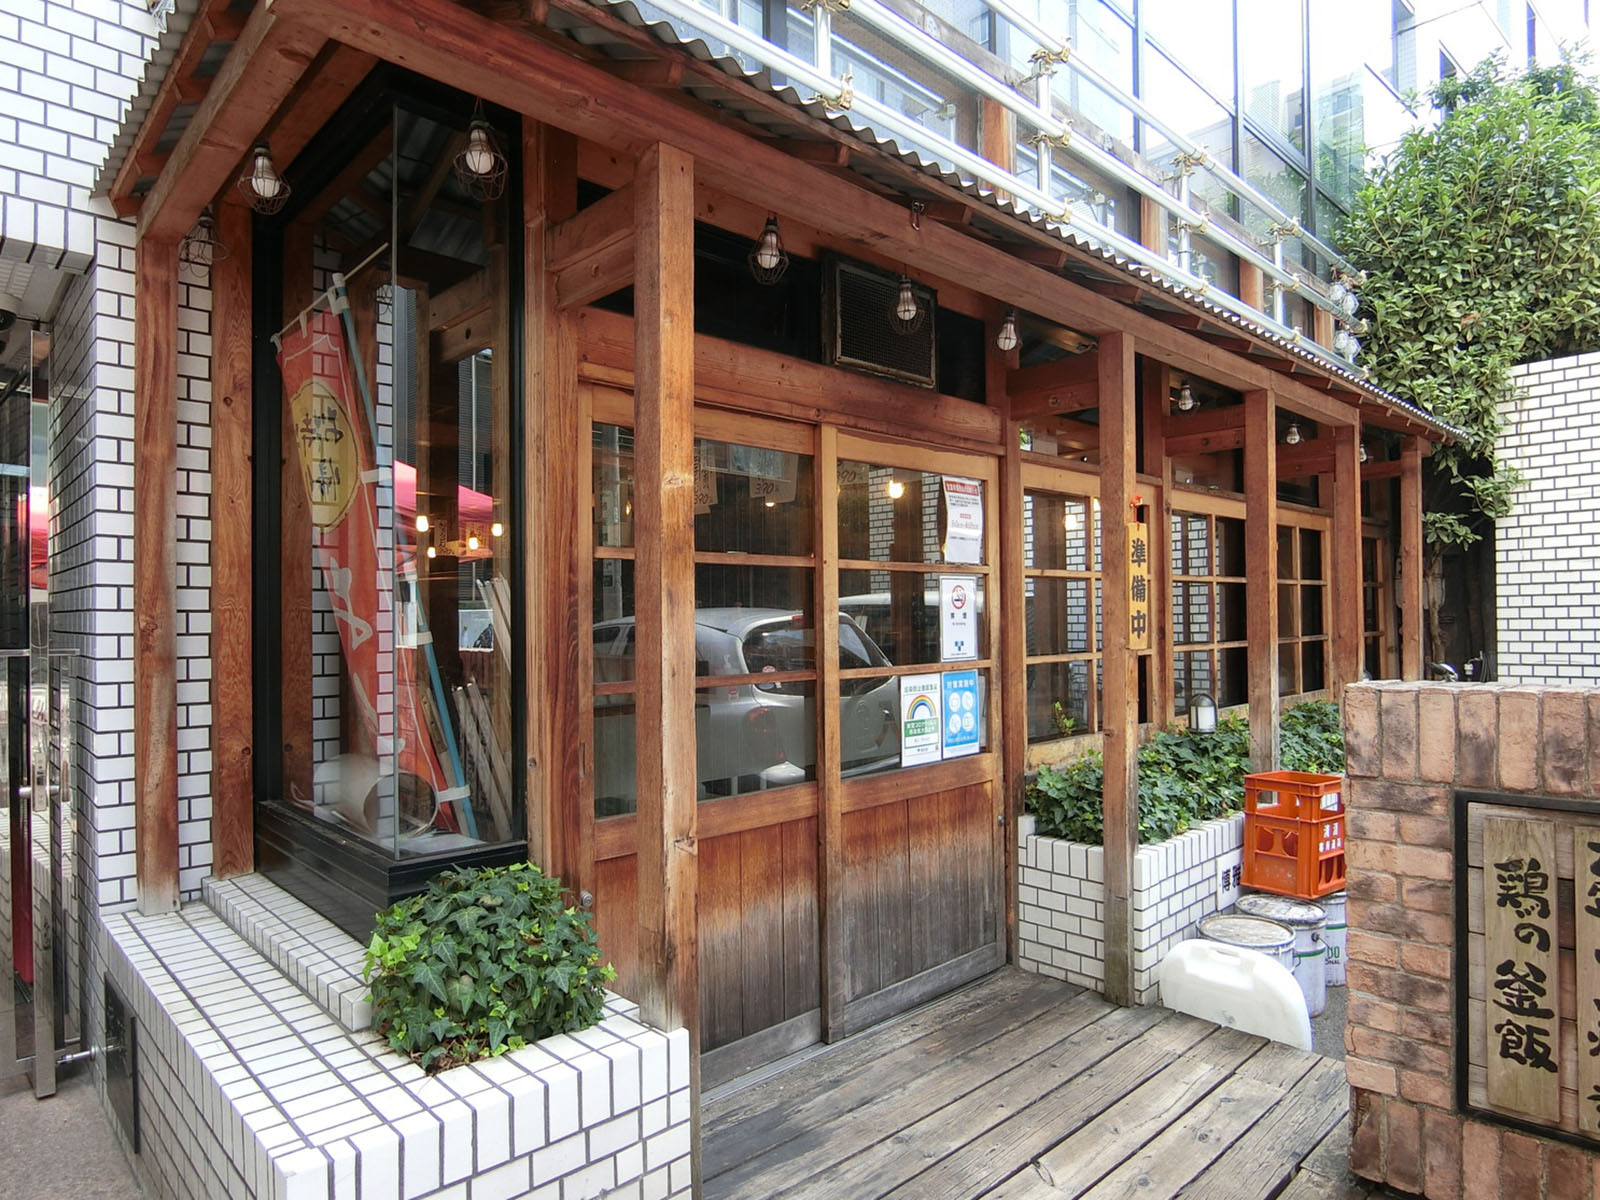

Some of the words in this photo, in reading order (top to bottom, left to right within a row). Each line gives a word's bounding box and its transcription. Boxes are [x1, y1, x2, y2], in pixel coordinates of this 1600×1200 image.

[1131, 537, 1147, 640] 準備中
[1493, 857, 1558, 1073] 鶏の釜飯
